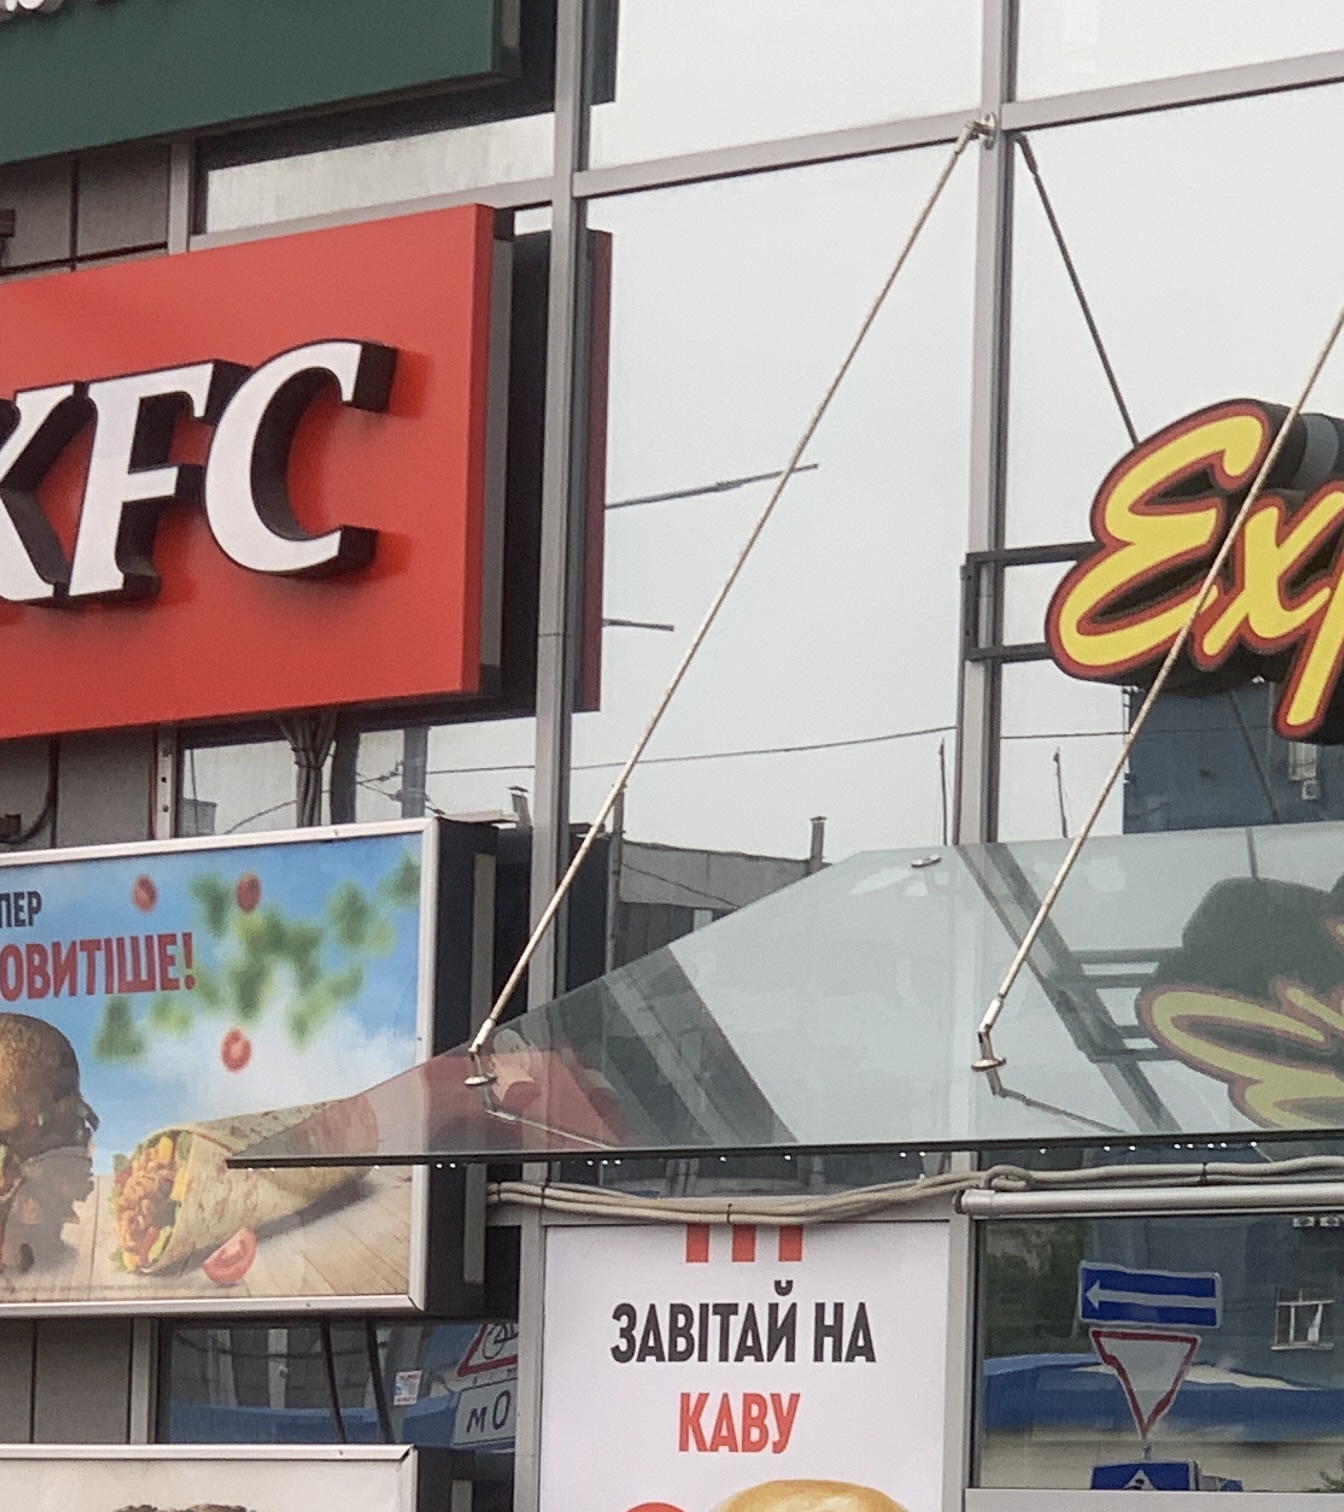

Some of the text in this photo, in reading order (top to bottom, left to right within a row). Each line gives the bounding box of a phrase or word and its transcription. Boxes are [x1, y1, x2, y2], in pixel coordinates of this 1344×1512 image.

[610, 1279, 877, 1364] ЗАВІТАЙ НА
[678, 1392, 801, 1454] КАВУ
